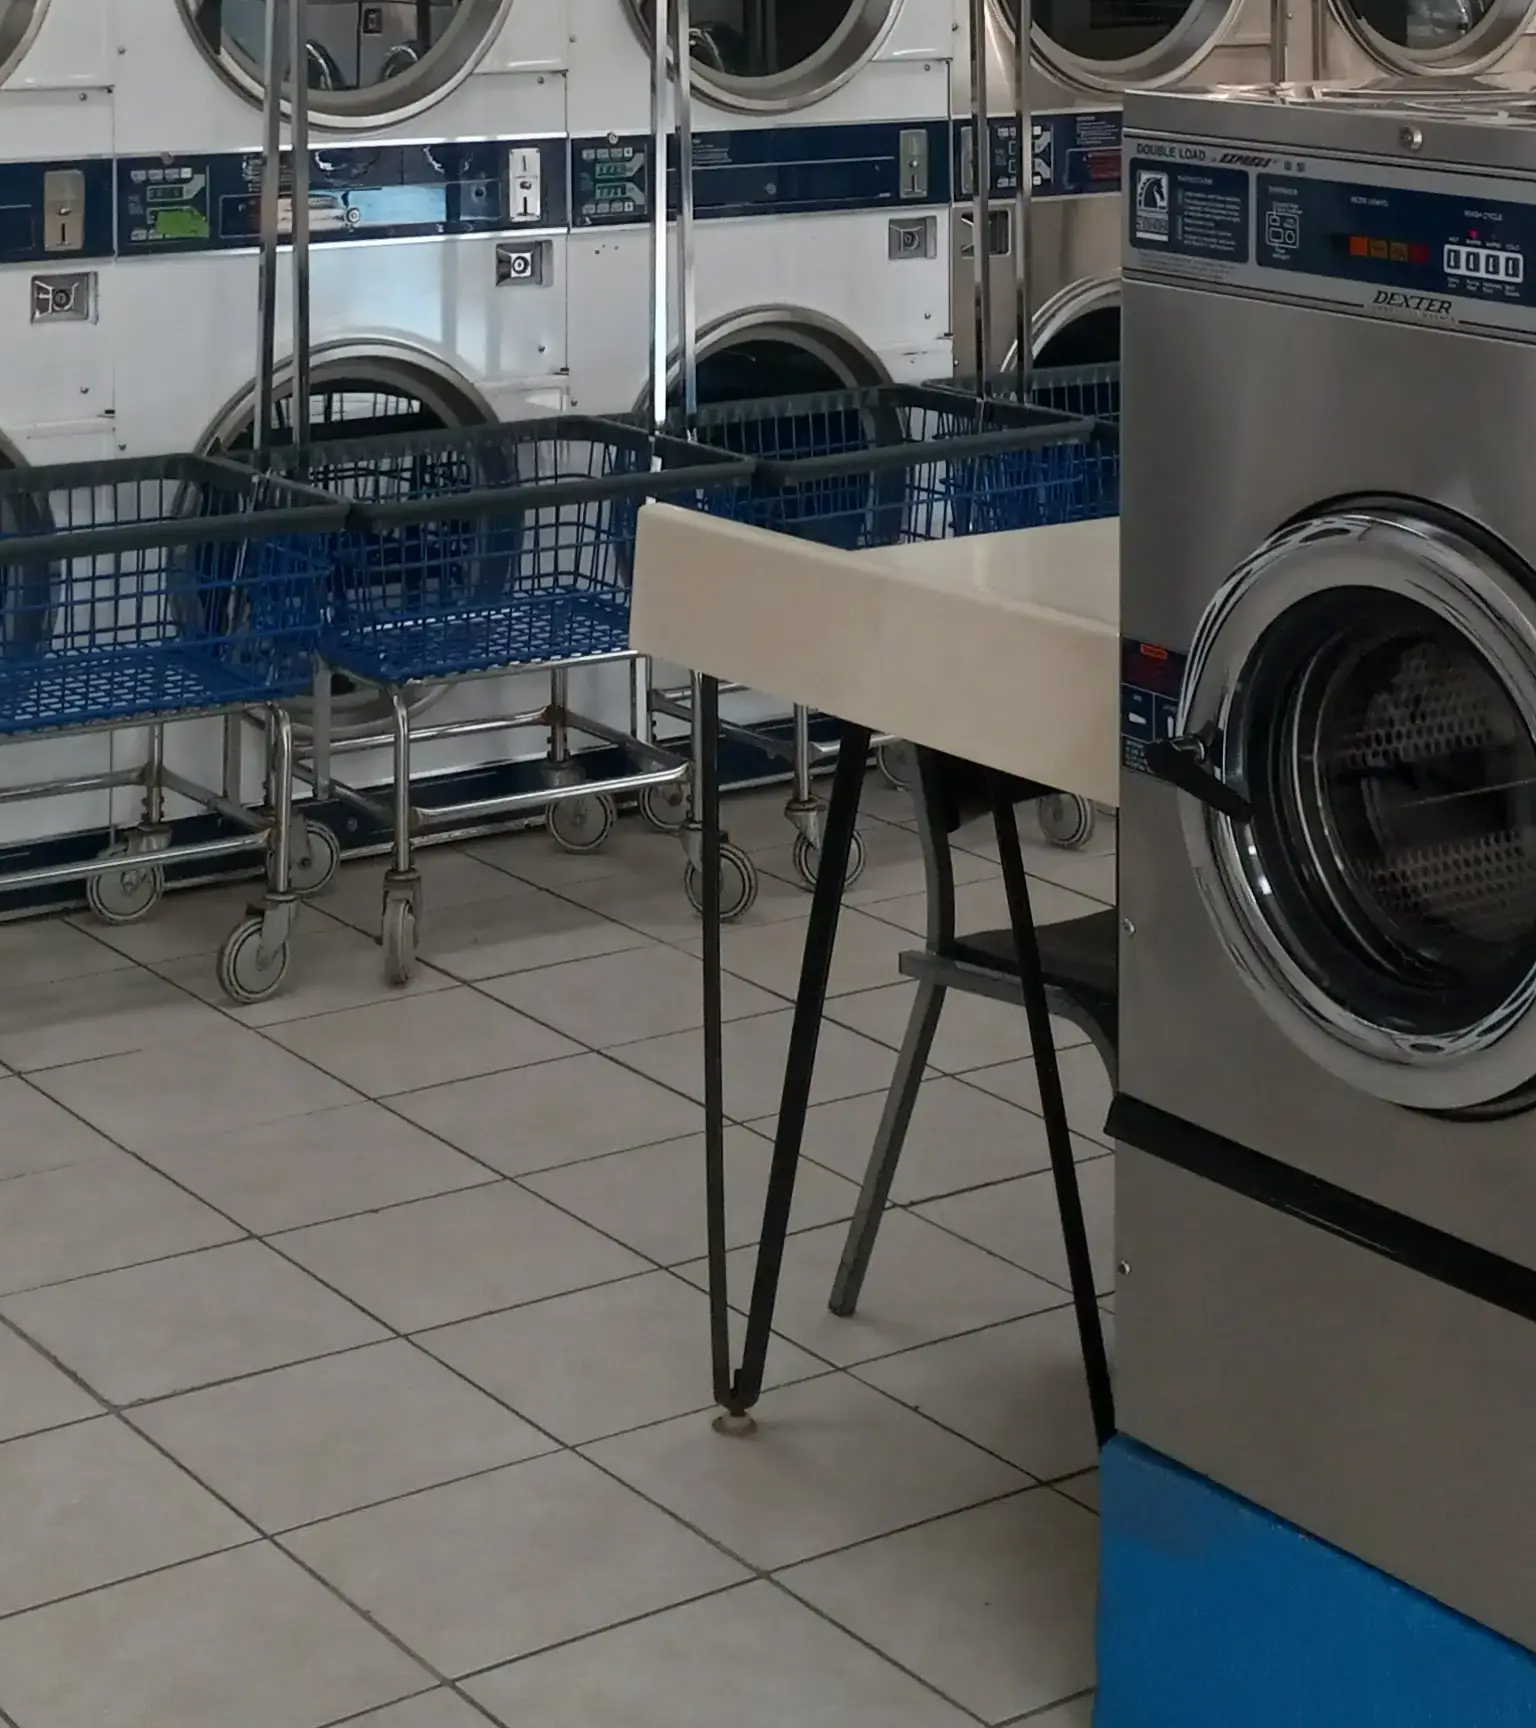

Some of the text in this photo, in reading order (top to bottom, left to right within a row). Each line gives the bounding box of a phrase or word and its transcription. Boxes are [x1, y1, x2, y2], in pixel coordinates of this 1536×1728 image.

[1137, 143, 1177, 159] DOUBLE
[1179, 147, 1206, 162] LOAD
[1373, 290, 1452, 315] DEXTER
